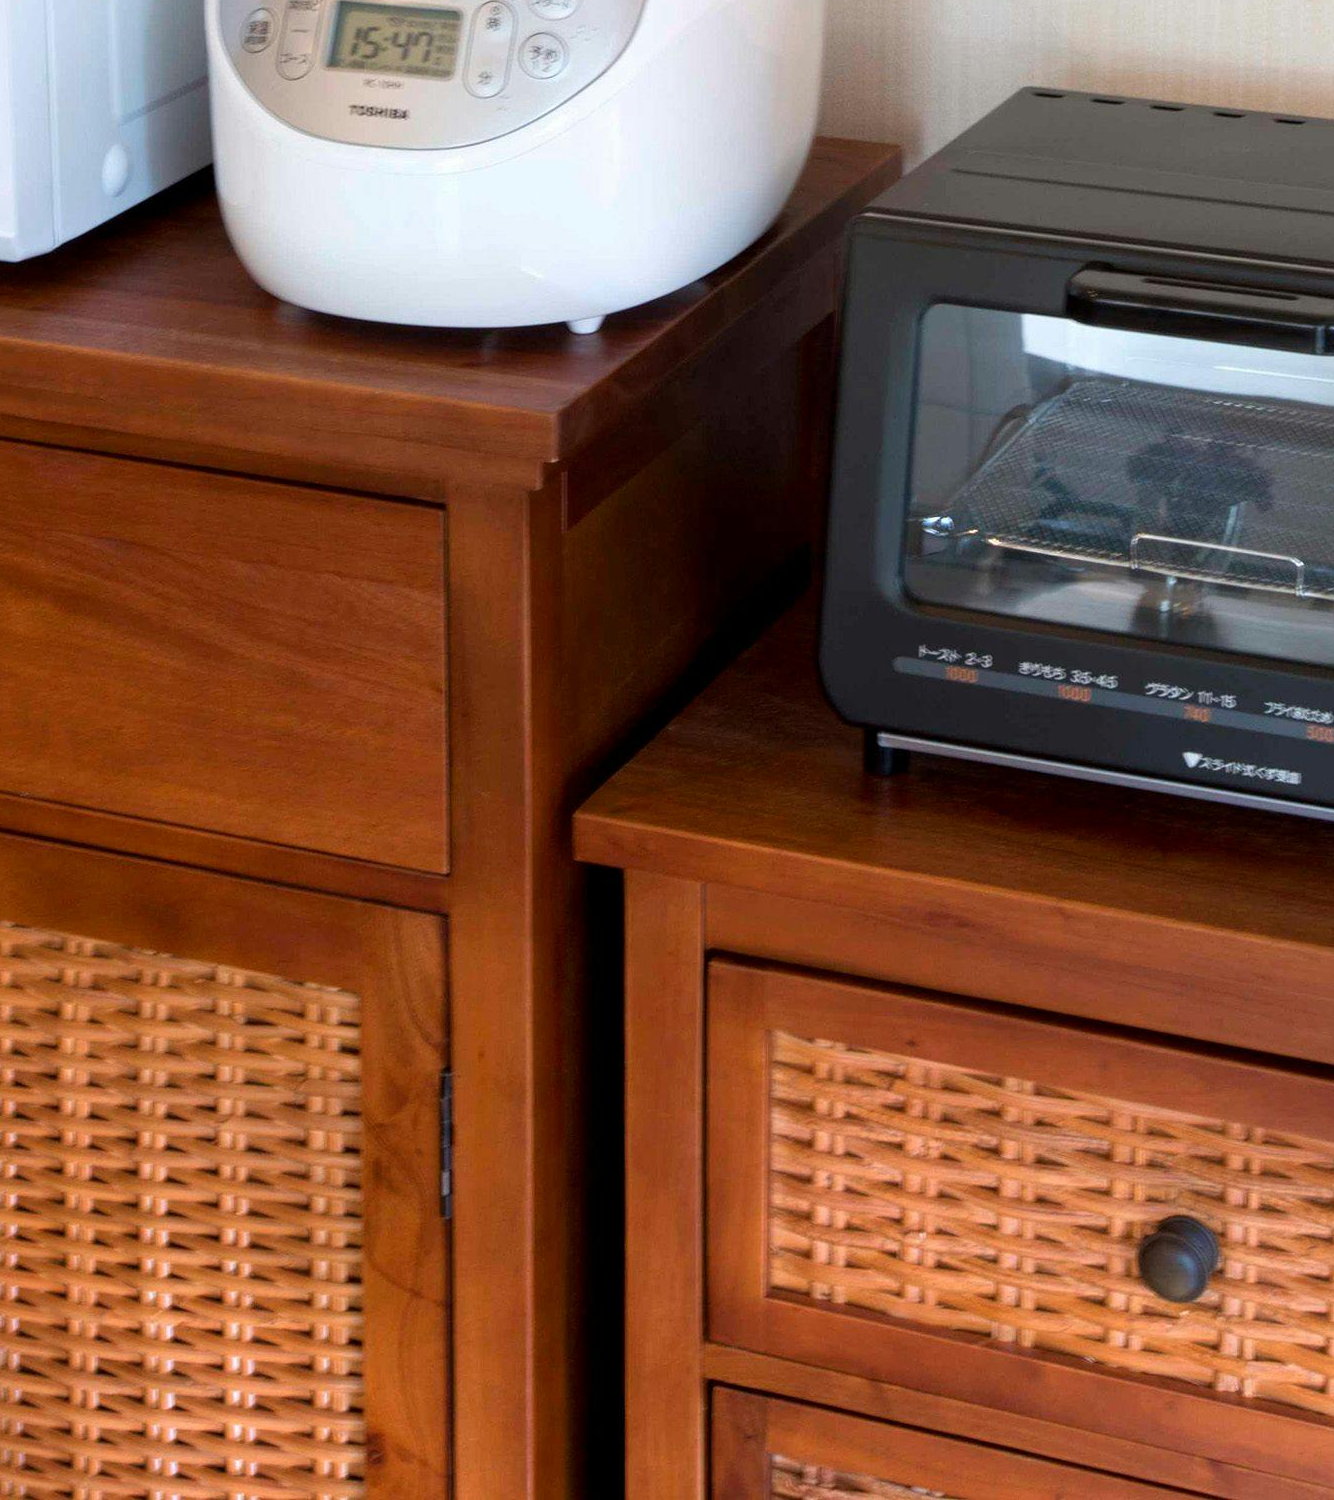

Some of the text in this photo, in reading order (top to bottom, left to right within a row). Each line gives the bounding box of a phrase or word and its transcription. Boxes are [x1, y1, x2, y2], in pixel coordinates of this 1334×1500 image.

[348, 104, 410, 120] TOSHIBA
[964, 652, 993, 668] 2-3
[1145, 682, 1194, 700] グラタン
